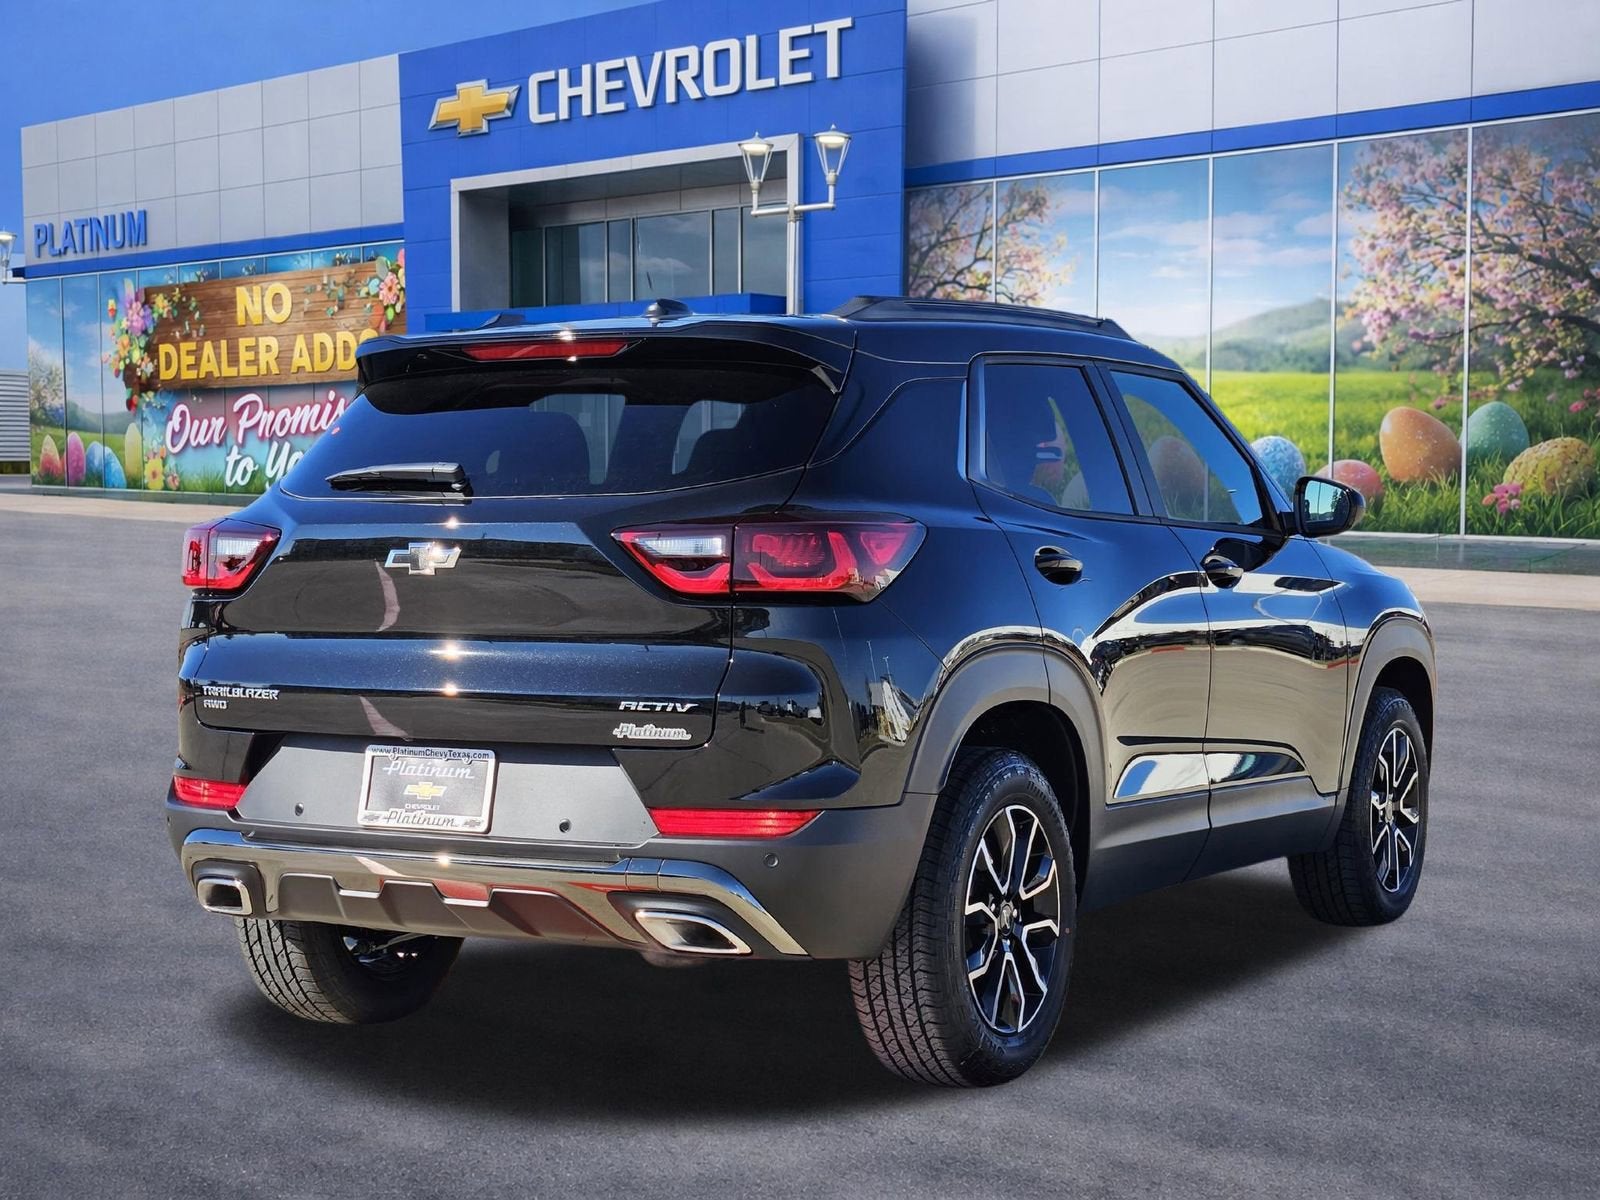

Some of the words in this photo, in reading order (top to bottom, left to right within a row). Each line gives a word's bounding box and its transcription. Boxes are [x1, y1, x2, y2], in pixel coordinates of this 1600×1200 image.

[528, 17, 853, 124] CHEVROLET
[34, 209, 147, 258] PLATINUM
[236, 282, 292, 325] NO
[158, 339, 280, 380] DEALER
[290, 328, 378, 372] ADD
[165, 403, 227, 454] Our
[224, 443, 258, 486] to
[202, 685, 280, 700] TRAILBLAZER
[203, 699, 228, 709] AWD
[619, 701, 699, 712] ACTIV
[612, 722, 692, 740] Platinum
[371, 747, 490, 759] www.PlatinumChevyTexas.com
[382, 760, 475, 779] Platinum
[405, 803, 441, 811] CHEVROLET
[383, 810, 459, 828] Platinum
